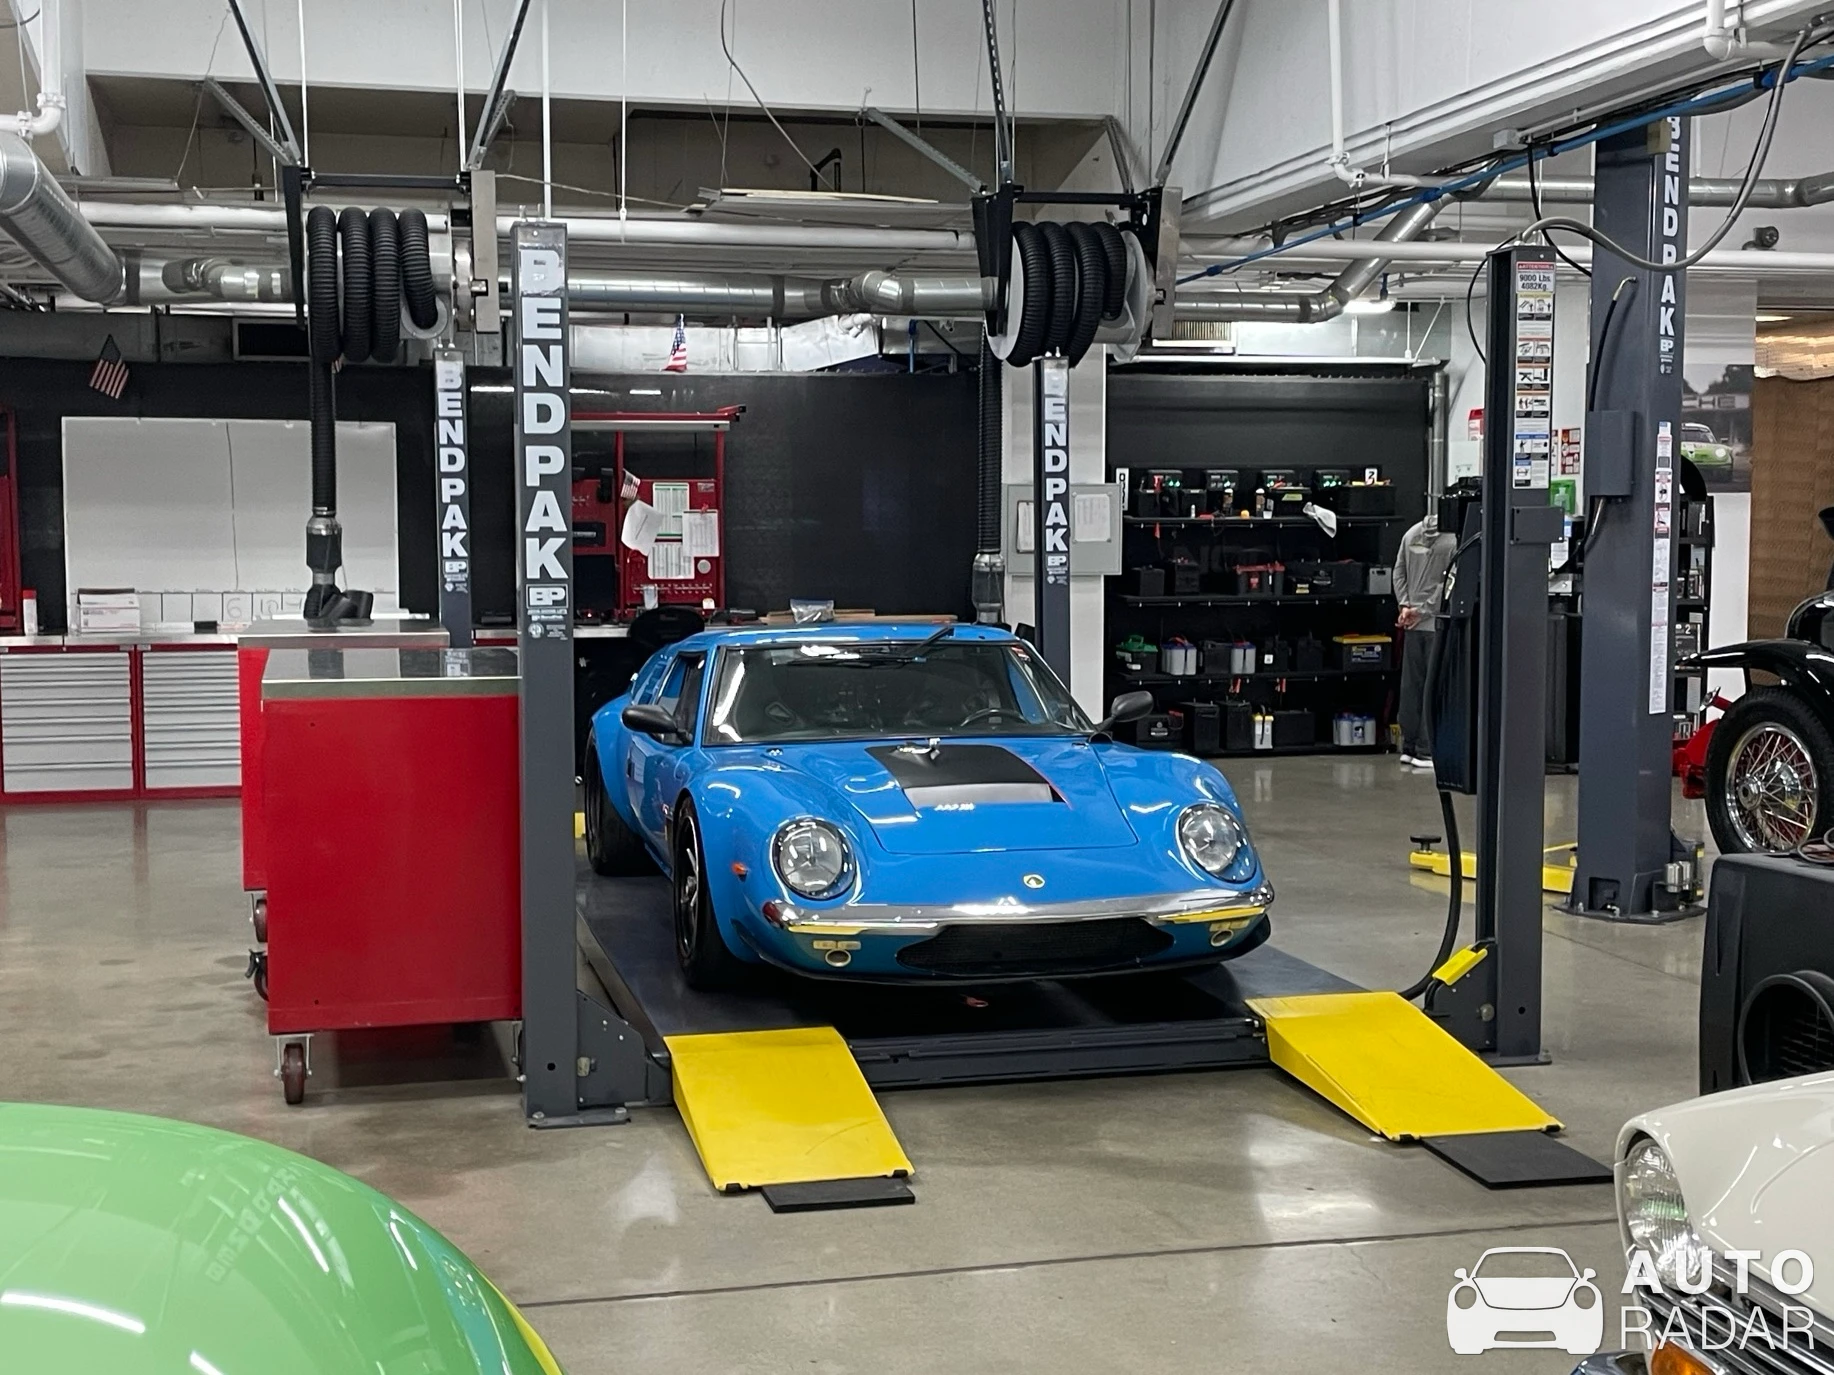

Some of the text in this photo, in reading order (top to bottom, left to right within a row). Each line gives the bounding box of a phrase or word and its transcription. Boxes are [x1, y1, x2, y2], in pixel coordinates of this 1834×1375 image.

[436, 361, 468, 558] BENDPAK
[520, 249, 569, 580] BENDPAK
[1044, 369, 1068, 552] BENDPAK
[528, 587, 566, 606] BP
